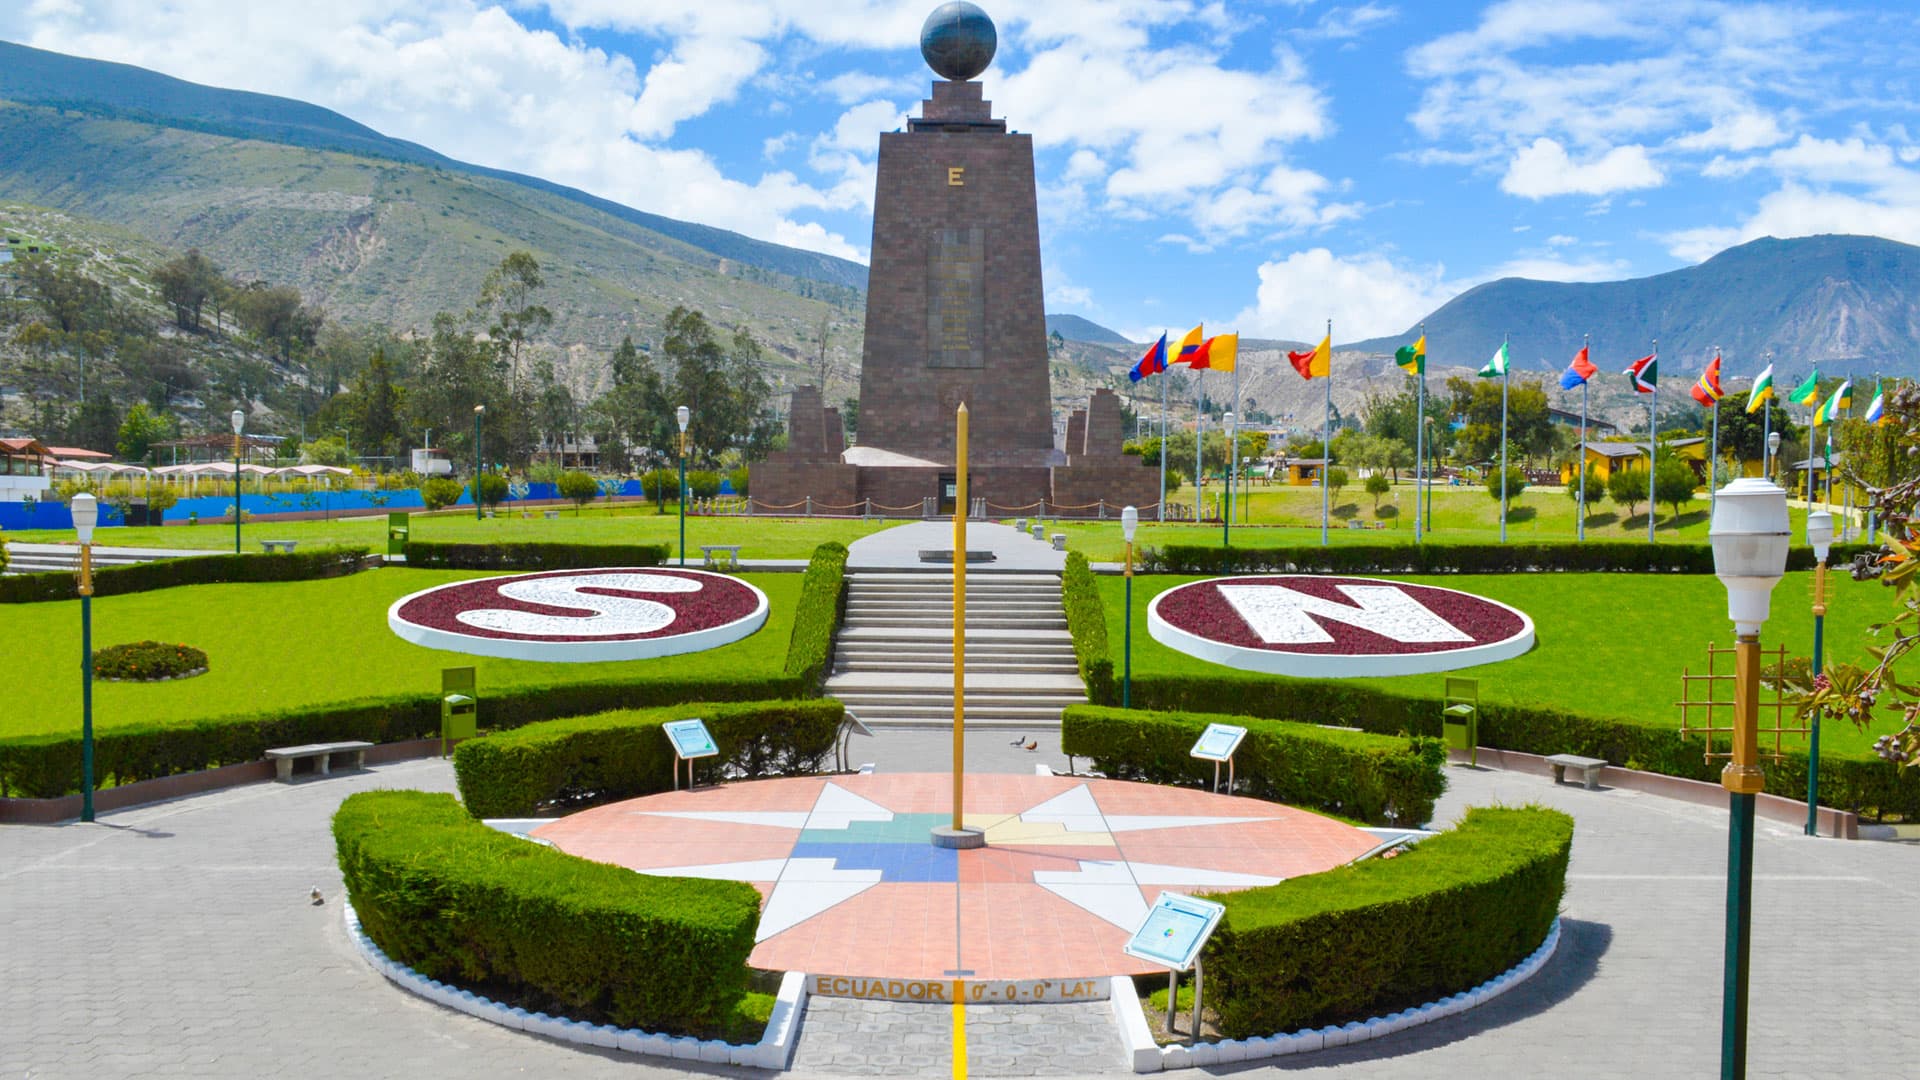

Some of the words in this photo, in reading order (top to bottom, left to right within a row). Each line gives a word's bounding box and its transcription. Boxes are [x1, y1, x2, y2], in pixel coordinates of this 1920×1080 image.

[948, 167, 965, 186] E
[455, 573, 704, 636] S
[1216, 584, 1476, 644] N
[816, 976, 945, 1000] ECUADOR
[1061, 980, 1098, 998] LAT.
